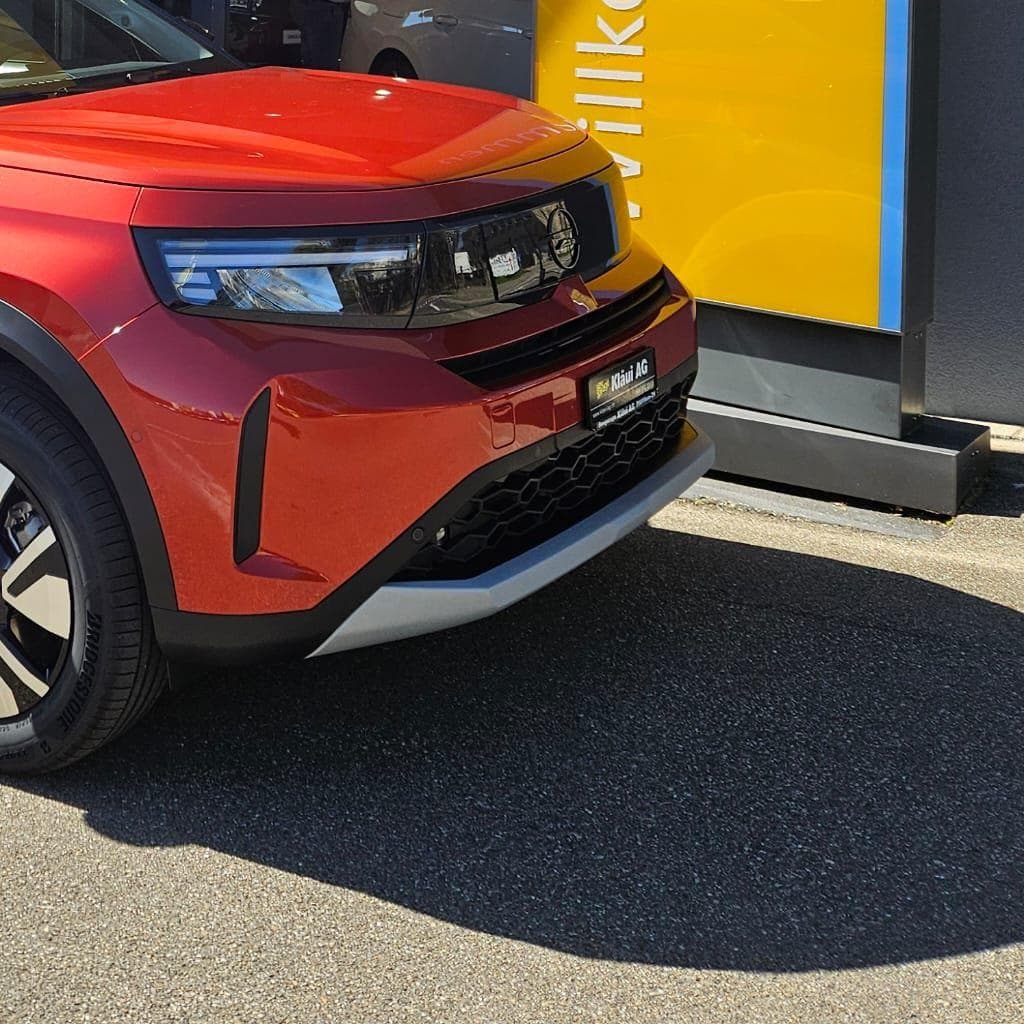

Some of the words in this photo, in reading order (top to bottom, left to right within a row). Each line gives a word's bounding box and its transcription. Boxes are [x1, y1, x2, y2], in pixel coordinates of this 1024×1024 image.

[610, 364, 634, 392] Kläui
[635, 358, 649, 379] AG
[56, 609, 103, 733] BRIDGESTONE
